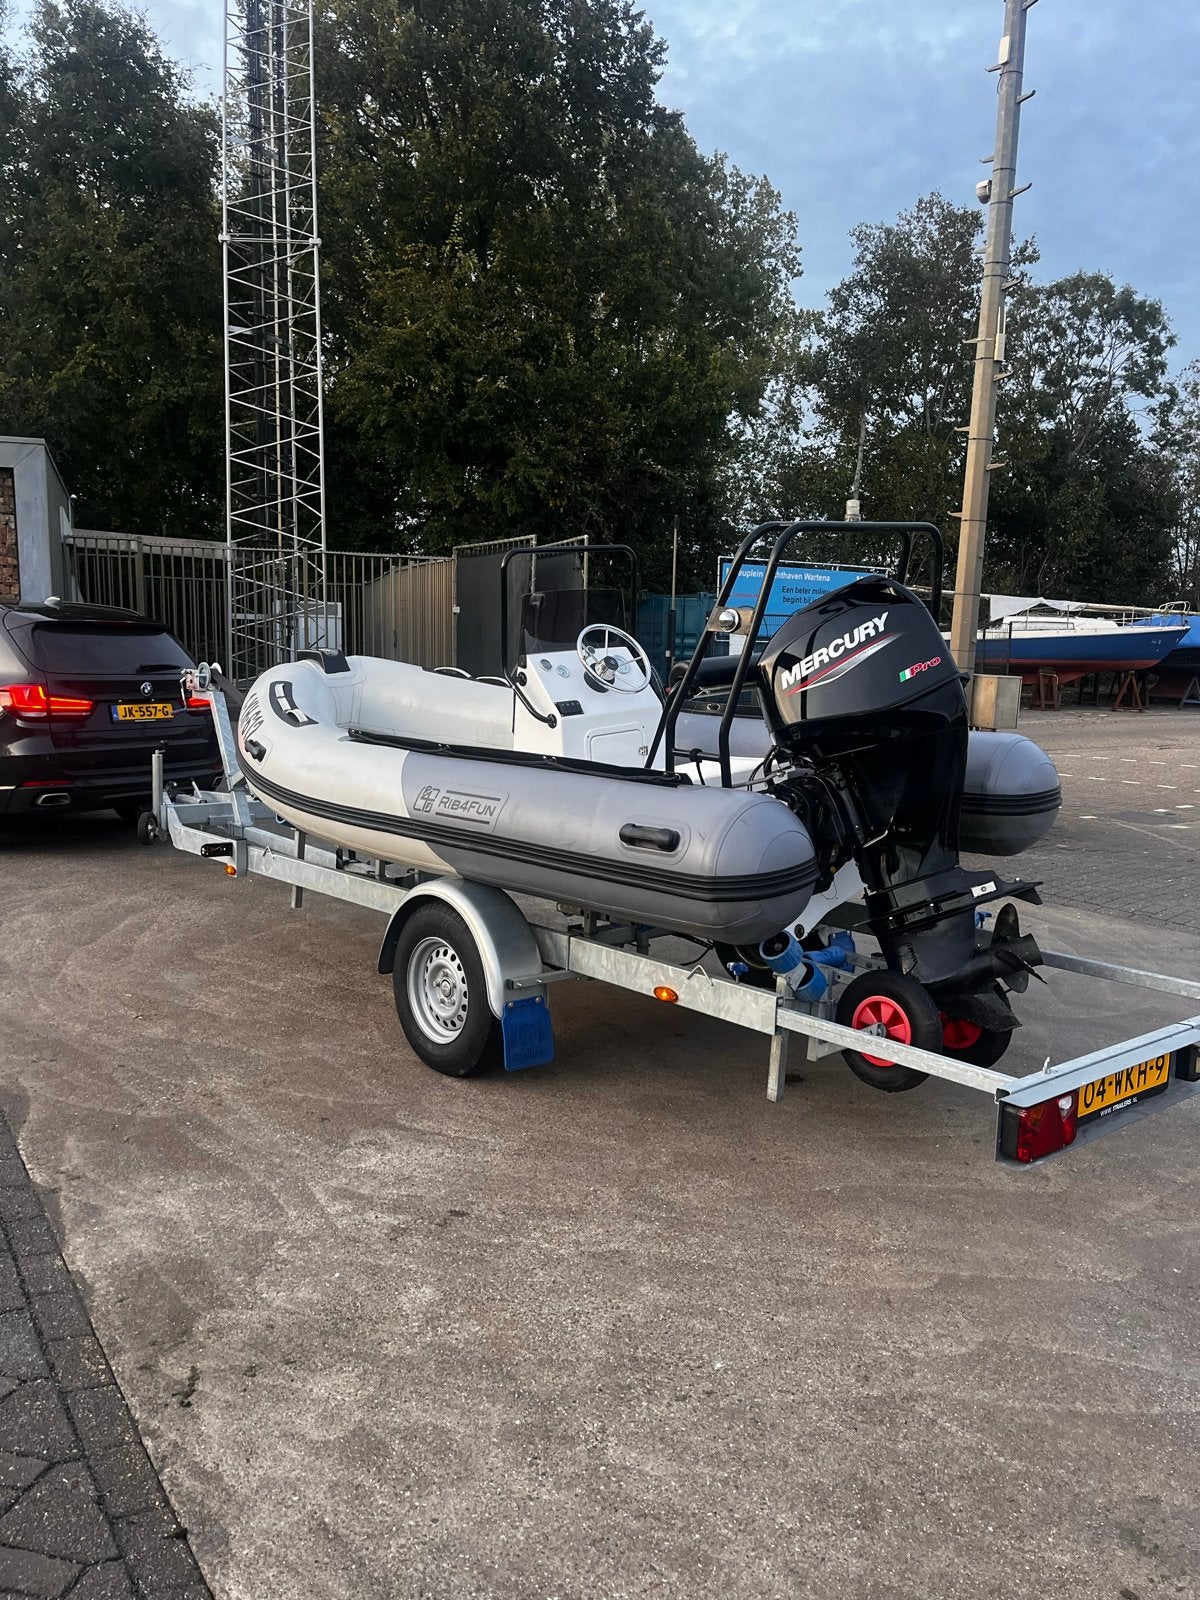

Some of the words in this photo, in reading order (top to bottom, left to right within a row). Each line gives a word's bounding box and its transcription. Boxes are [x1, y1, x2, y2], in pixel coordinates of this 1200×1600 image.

[804, 573, 831, 582] Wartena
[782, 585, 794, 594] Een
[795, 586, 811, 595] beter
[783, 595, 802, 605] begint
[781, 612, 889, 690] MERCURY
[910, 656, 942, 678] Pro
[122, 705, 170, 718] JK-557-G
[1084, 1054, 1166, 1109] 04-WKH-9
